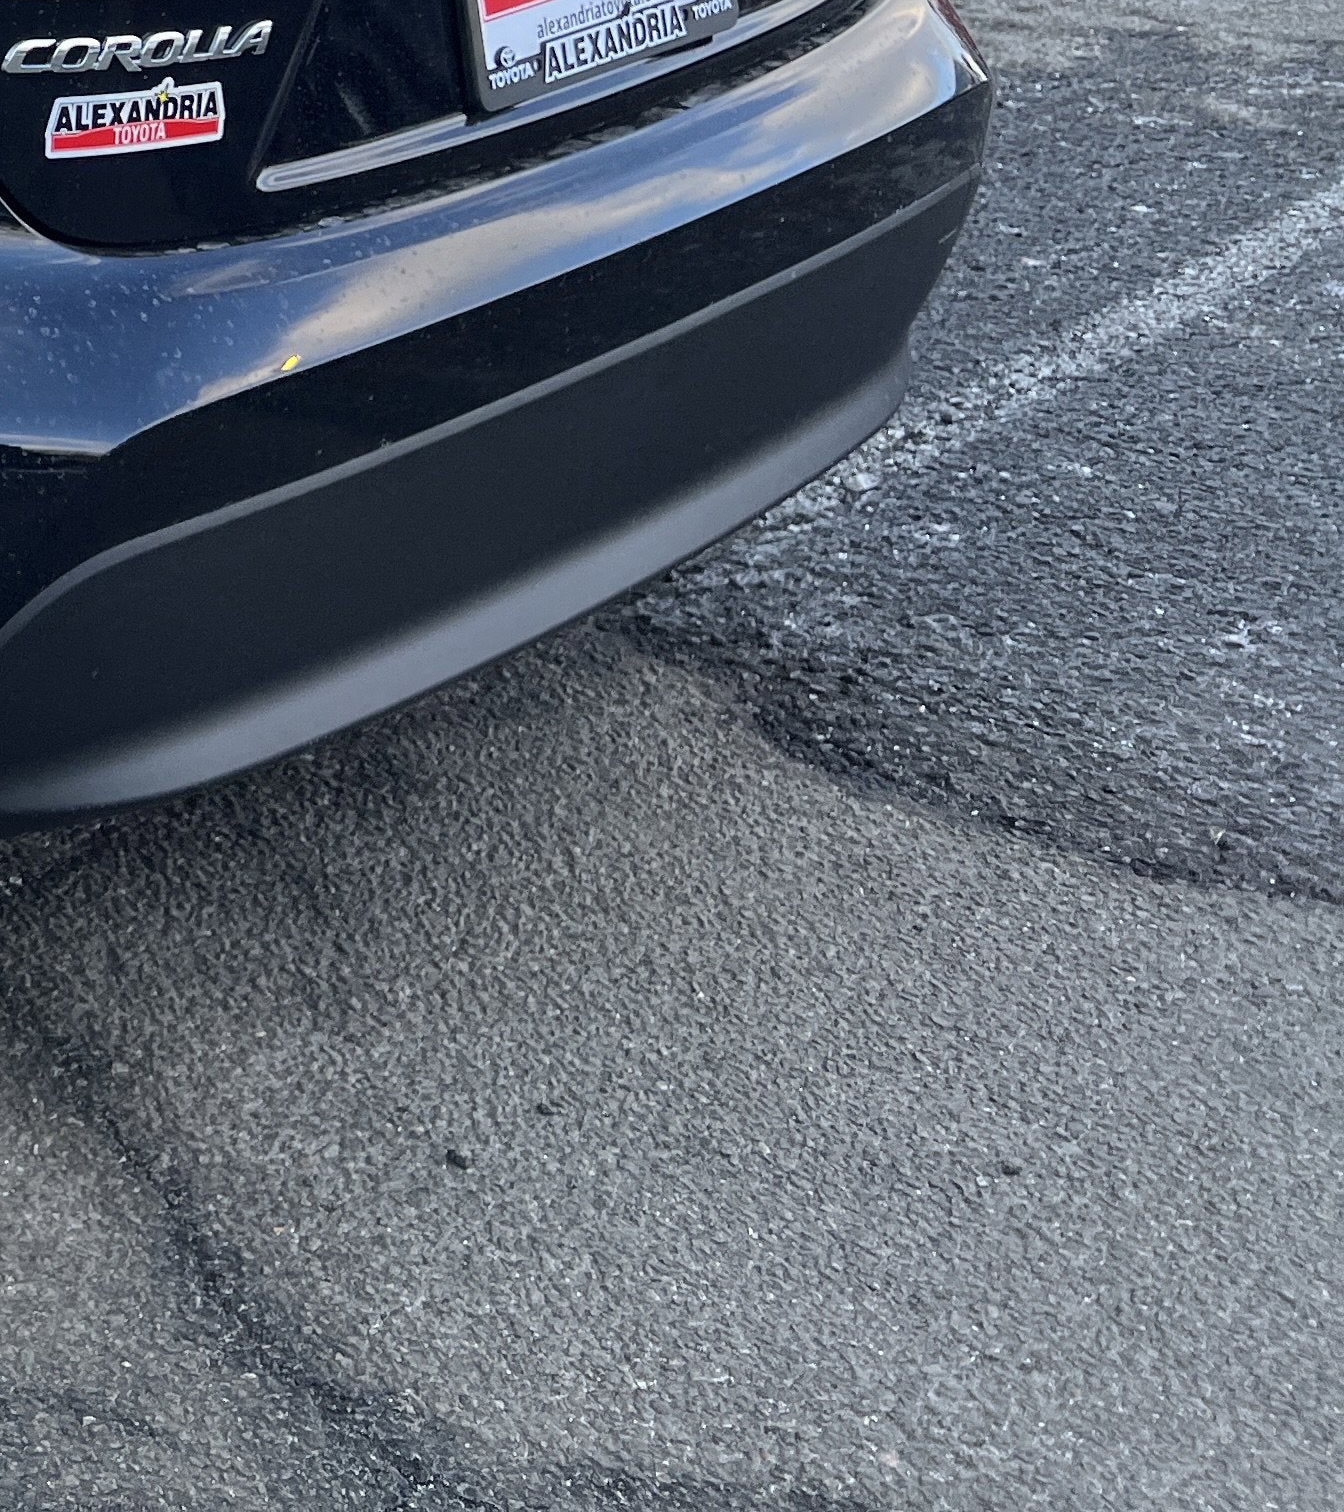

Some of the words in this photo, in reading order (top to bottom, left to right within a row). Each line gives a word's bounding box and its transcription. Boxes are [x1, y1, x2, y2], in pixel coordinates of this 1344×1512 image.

[1, 19, 273, 74] COROLLA
[543, 1, 688, 84] ALEXANDRIA
[488, 61, 536, 90] TOYOTA
[54, 90, 218, 133] ALEXANDRIA
[113, 121, 167, 145] TOYOTA
